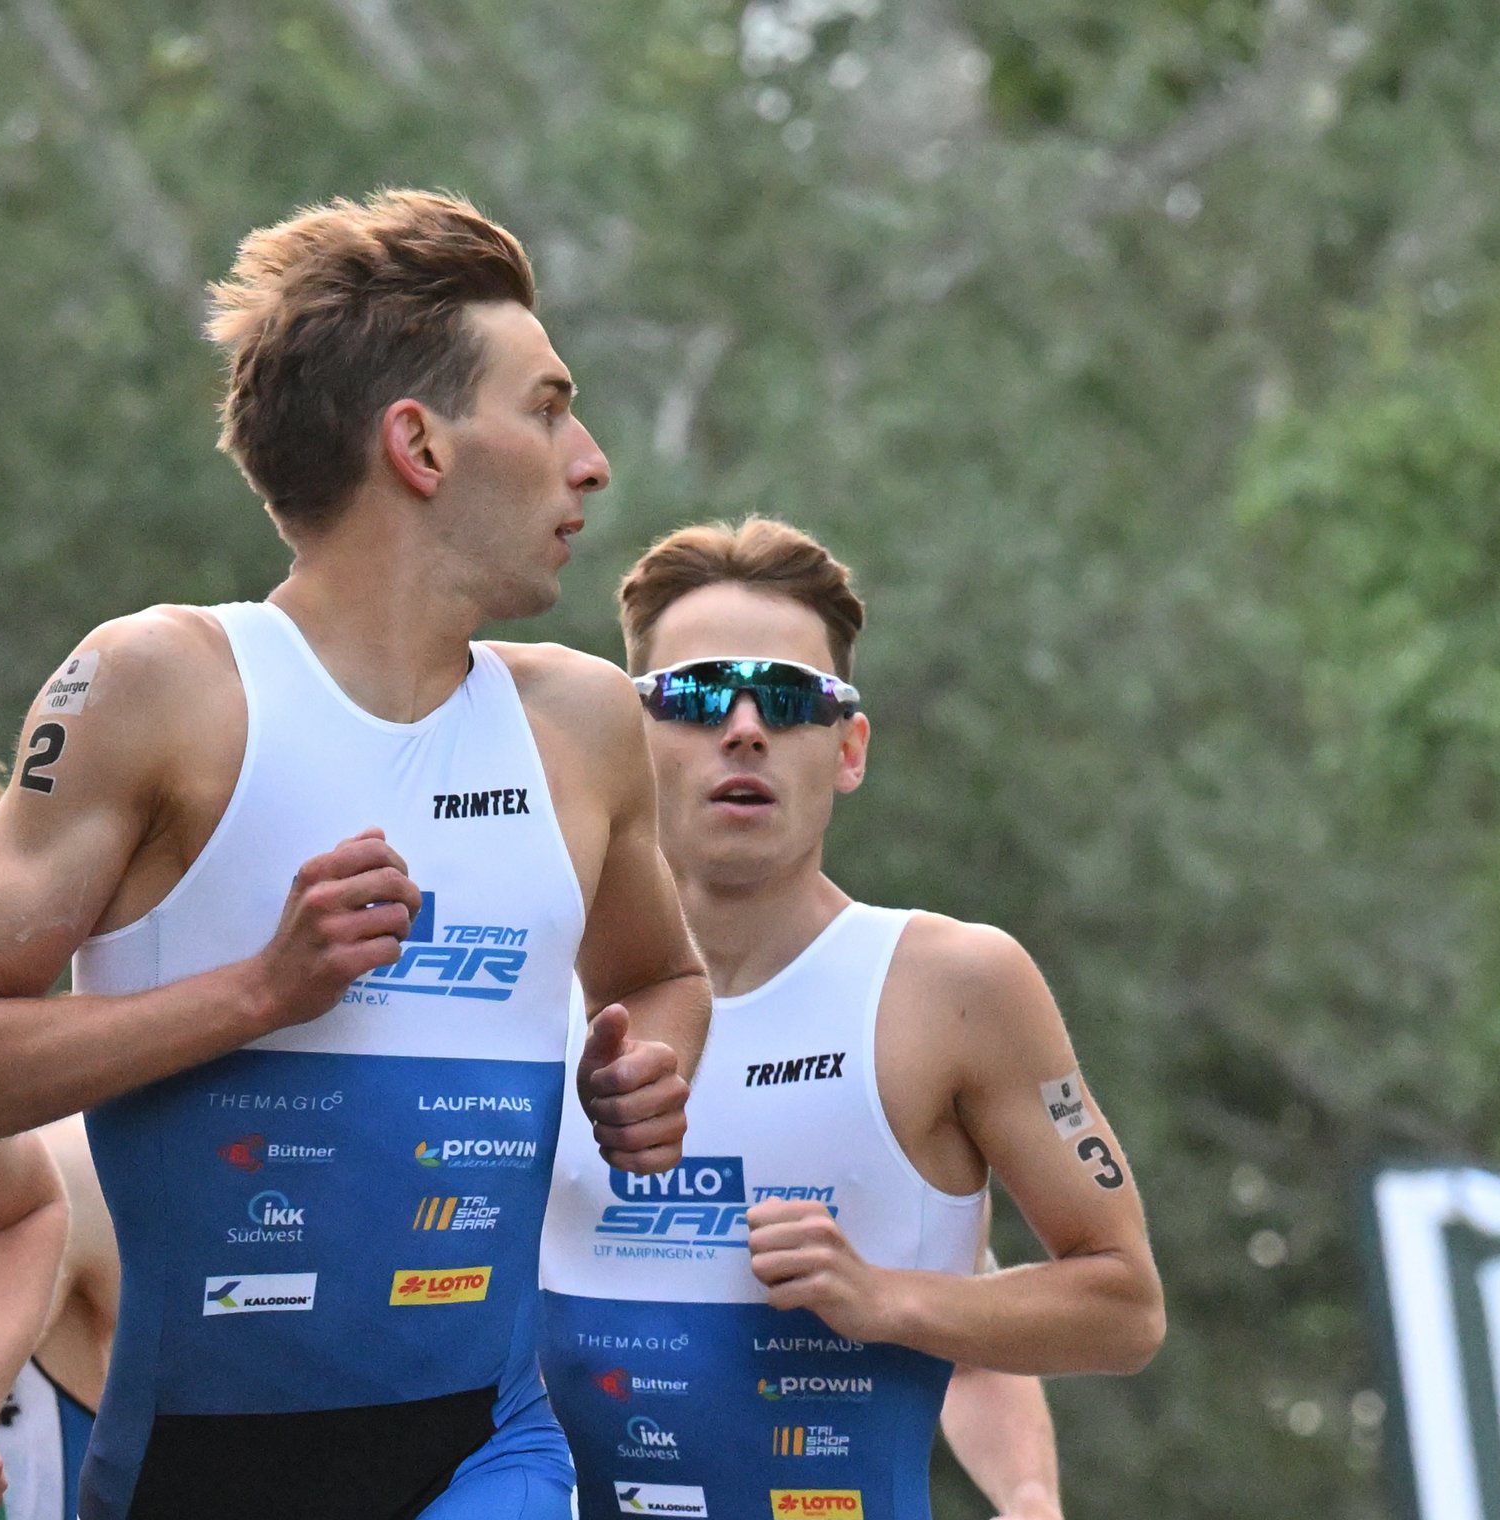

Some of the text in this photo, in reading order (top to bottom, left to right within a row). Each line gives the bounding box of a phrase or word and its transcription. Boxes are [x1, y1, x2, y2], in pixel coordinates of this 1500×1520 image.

[19, 722, 66, 794] 2
[432, 788, 531, 819] TRIMTEX
[443, 924, 529, 946] TEAM
[746, 1051, 846, 1087] TRIMTEX
[418, 1096, 532, 1112] LAUFMAUS
[267, 1143, 335, 1158] Büttner
[1077, 1136, 1124, 1189] 3
[461, 1195, 488, 1206] TRI
[455, 1206, 501, 1218] SHOP
[451, 1218, 497, 1231] SAAR
[227, 1227, 304, 1244] Südwest
[616, 1246, 693, 1260] MARPINGEN
[428, 1273, 485, 1293] LOTTO
[244, 1295, 308, 1307] KALODION
[753, 1337, 865, 1352] LAUFMAUS
[631, 1376, 689, 1391] Büttner
[807, 1425, 833, 1436] TRI
[806, 1436, 850, 1446] SHOP
[805, 1446, 849, 1456] SAAR
[647, 1502, 701, 1513] KALODION
[801, 1495, 857, 1511] LOTTO
